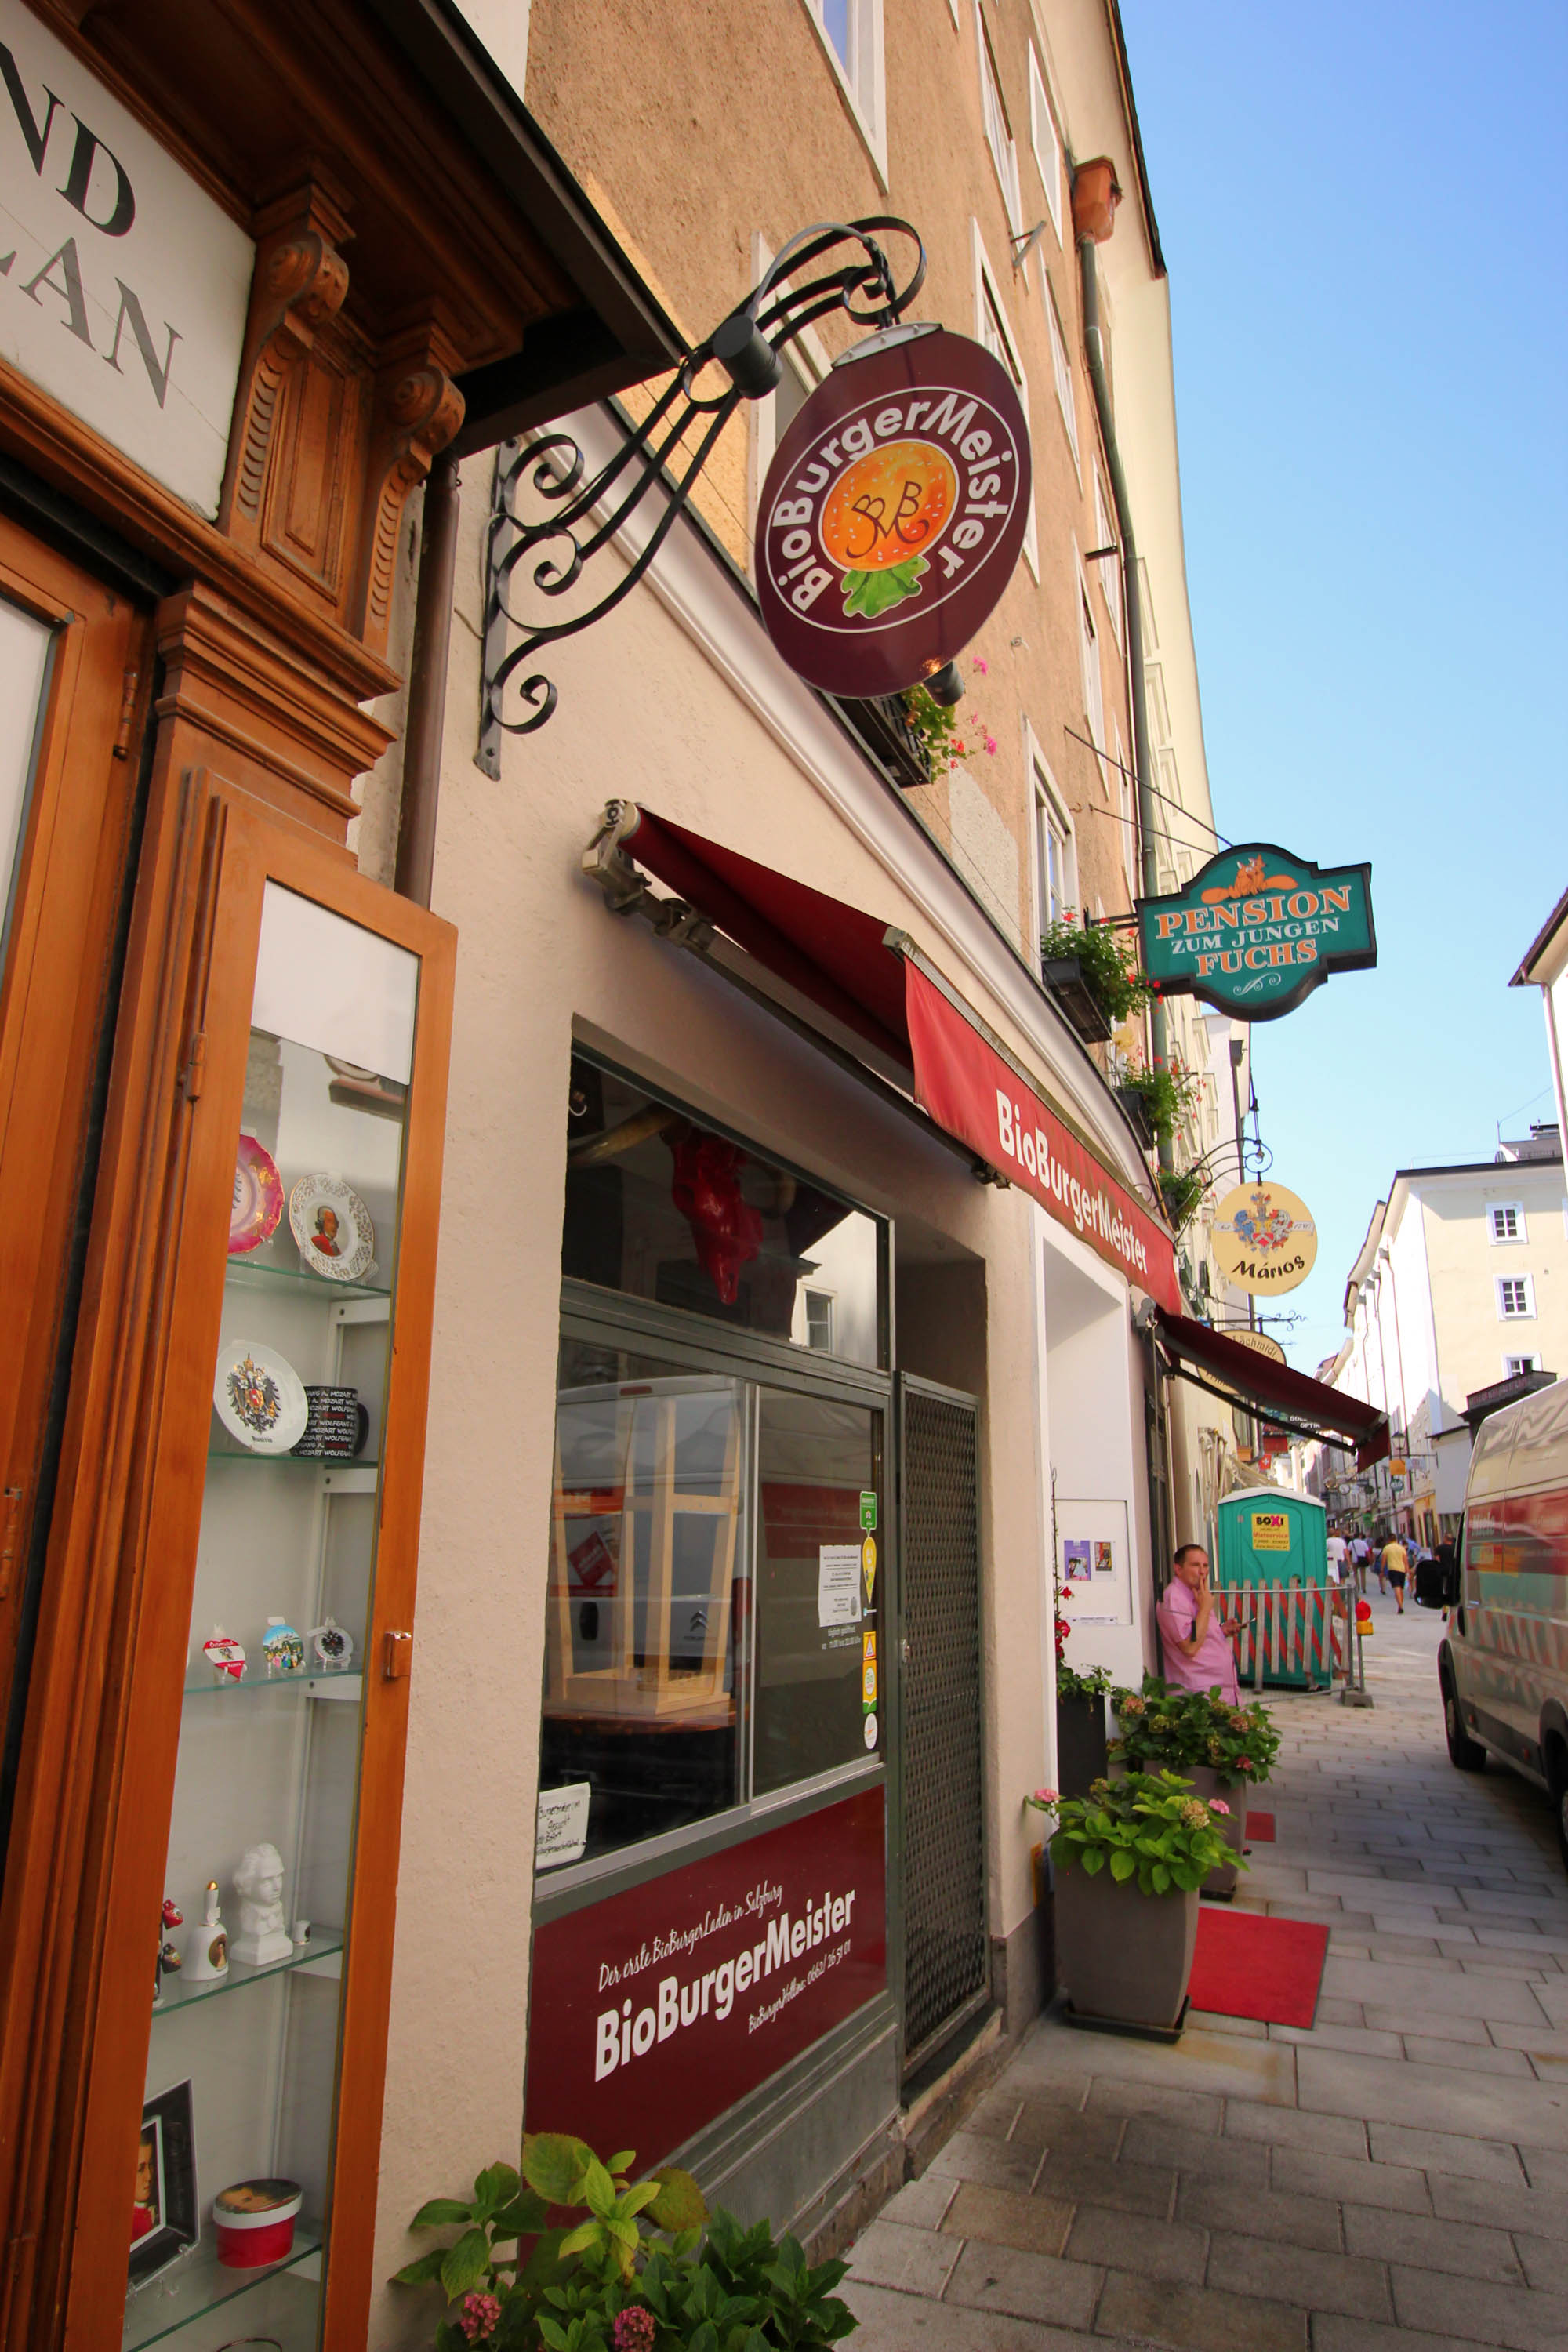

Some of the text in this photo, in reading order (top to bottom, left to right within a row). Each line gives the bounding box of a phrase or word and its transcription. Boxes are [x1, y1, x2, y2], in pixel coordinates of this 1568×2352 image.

[0, 237, 183, 409] AN
[772, 393, 1013, 612] BioBurgerMeister
[1154, 885, 1352, 940] PENSION
[1171, 917, 1340, 955] ZUM JUNGEN
[1195, 938, 1318, 978] FUCHS
[996, 1089, 1148, 1274] BioBurgerMeister
[1256, 1515, 1283, 1527] BOXI
[595, 1889, 855, 2083] BioBurgerMeister
[598, 1962, 622, 1993] Der
[623, 1943, 652, 1979] erste
[734, 1905, 745, 1921] in
[745, 1880, 782, 1918] Salzburg
